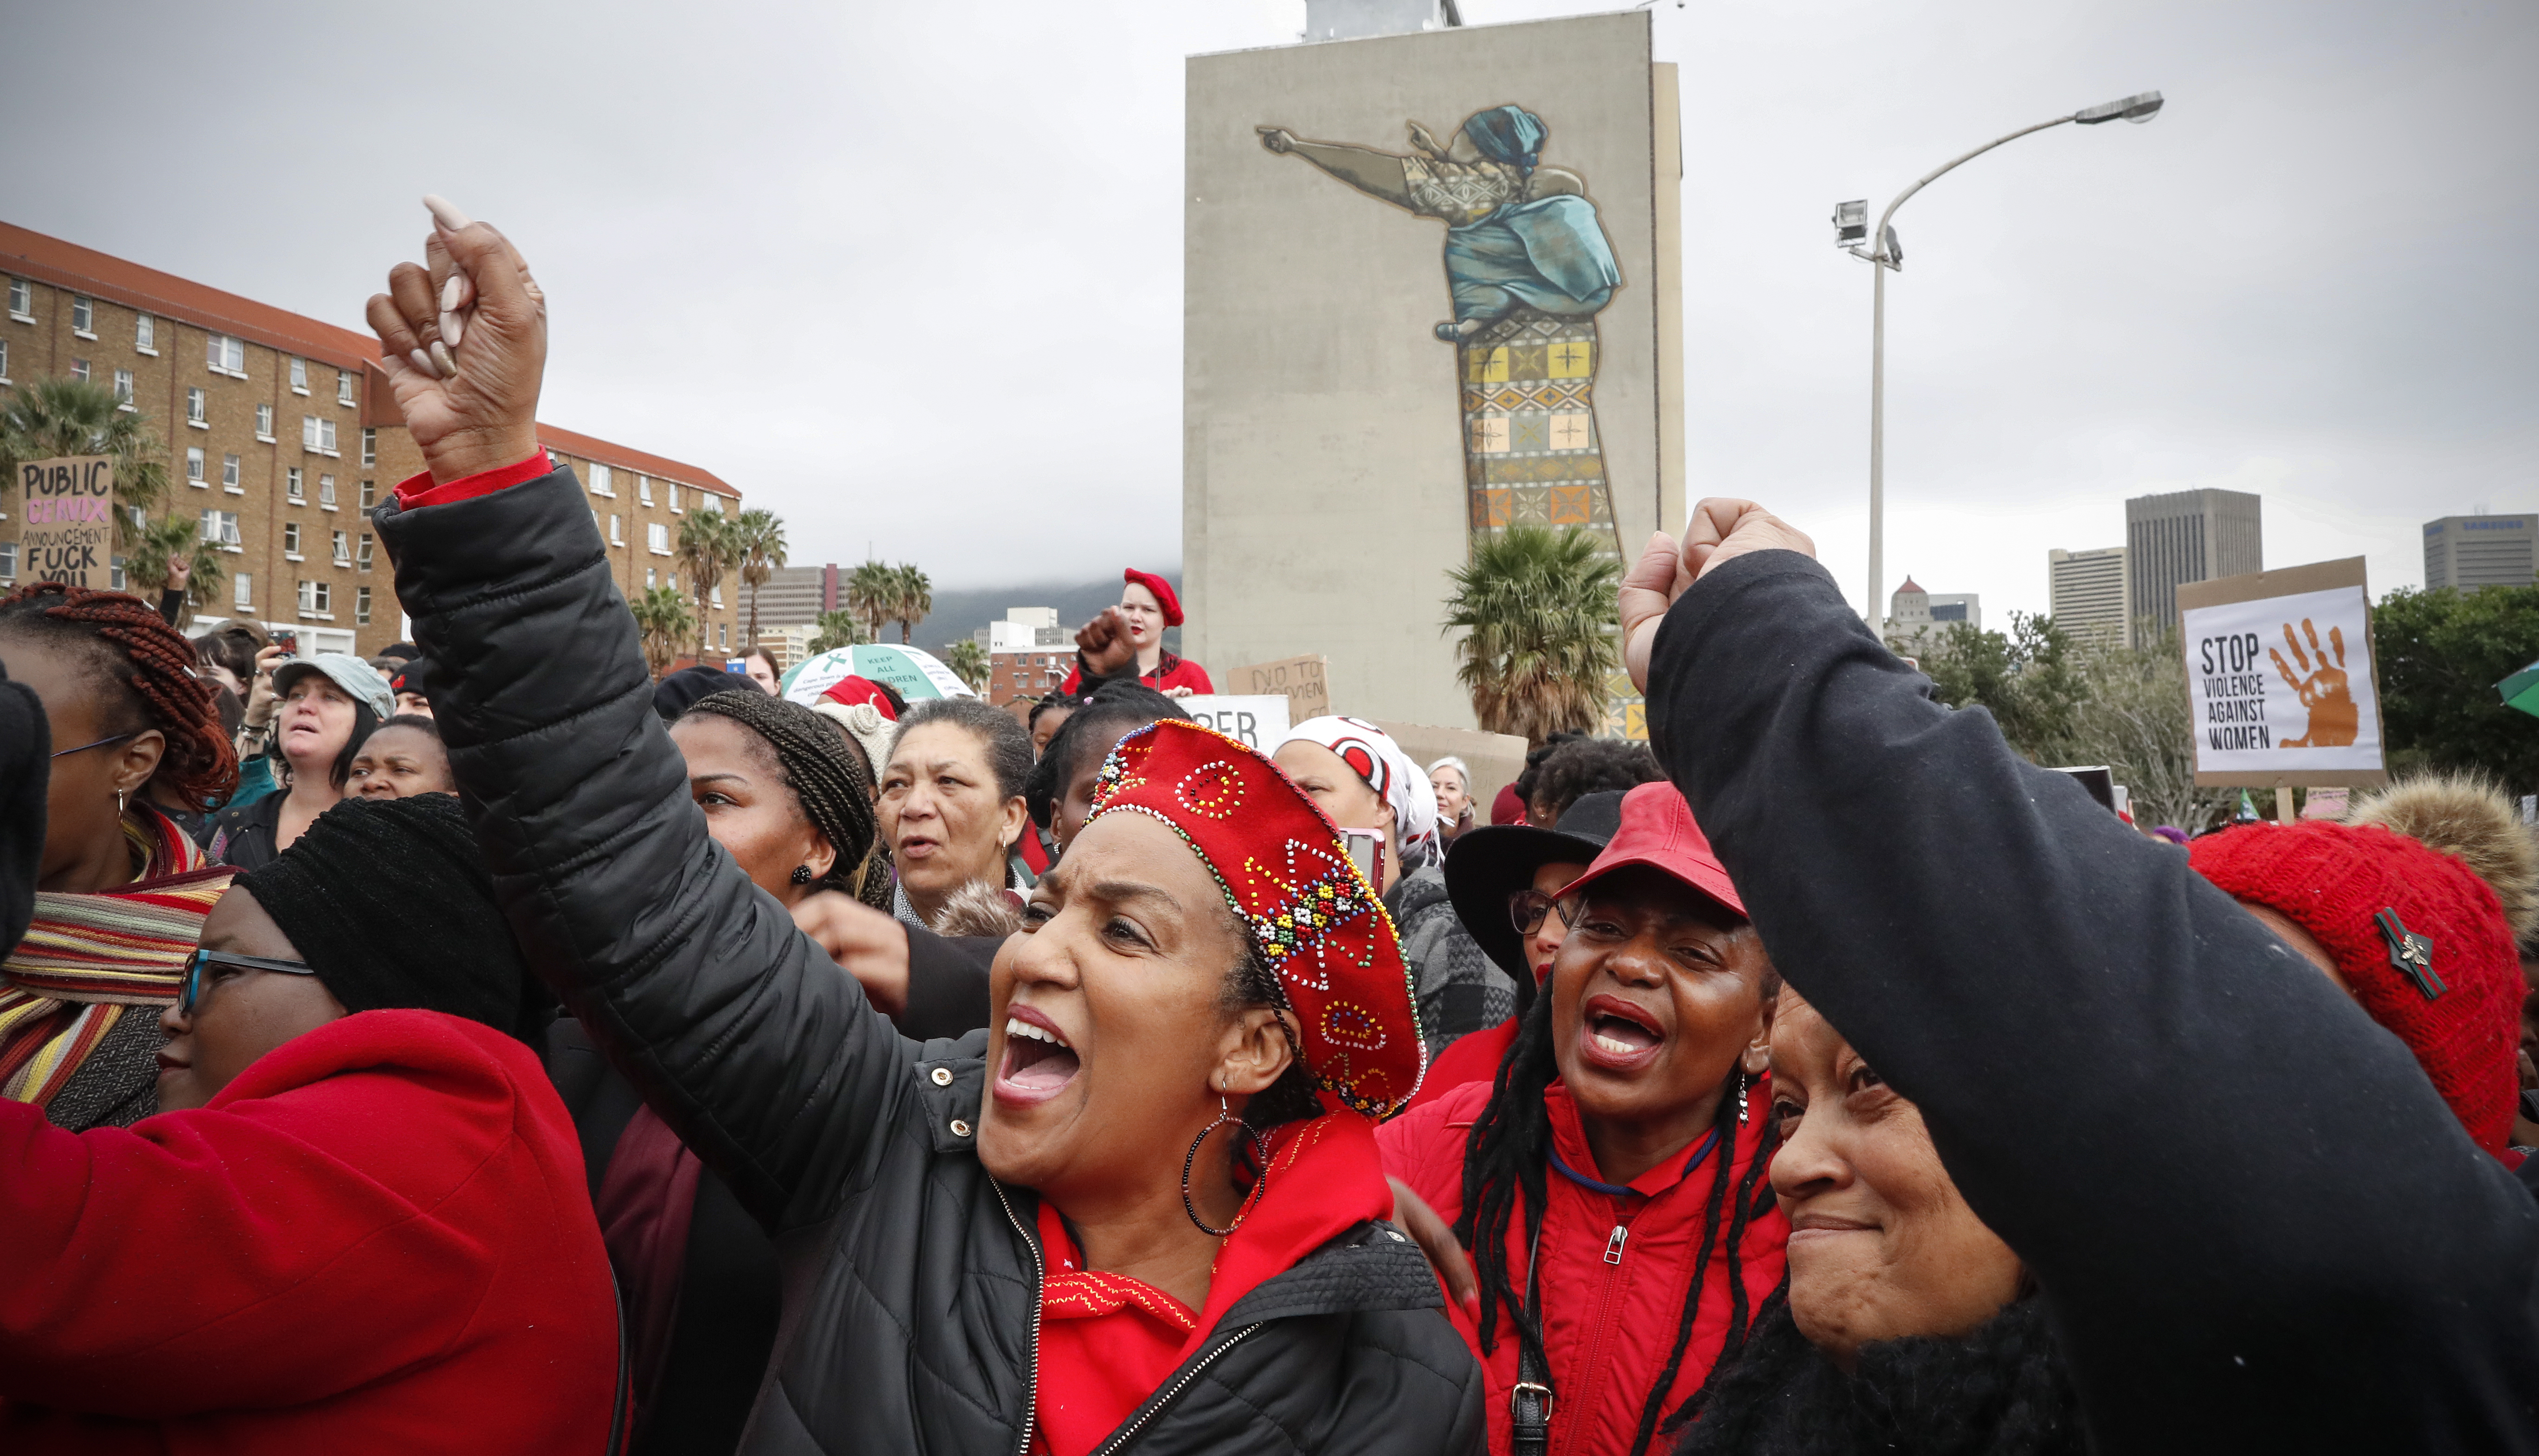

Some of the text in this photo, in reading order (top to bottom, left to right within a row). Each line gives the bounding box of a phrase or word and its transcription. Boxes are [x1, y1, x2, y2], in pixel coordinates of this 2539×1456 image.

[23, 461, 108, 499] PUBLIC
[27, 497, 107, 524] CERVIX
[23, 527, 110, 546] ANNOUNCEMENT
[27, 545, 98, 571] FUCK
[867, 656, 892, 664] KEEP
[2201, 633, 2259, 675] STOP
[1252, 661, 1322, 691] NO TO
[2204, 674, 2265, 698] VIOLENCE
[2209, 699, 2265, 723] AGAINST
[2209, 725, 2270, 750] WOMEN
